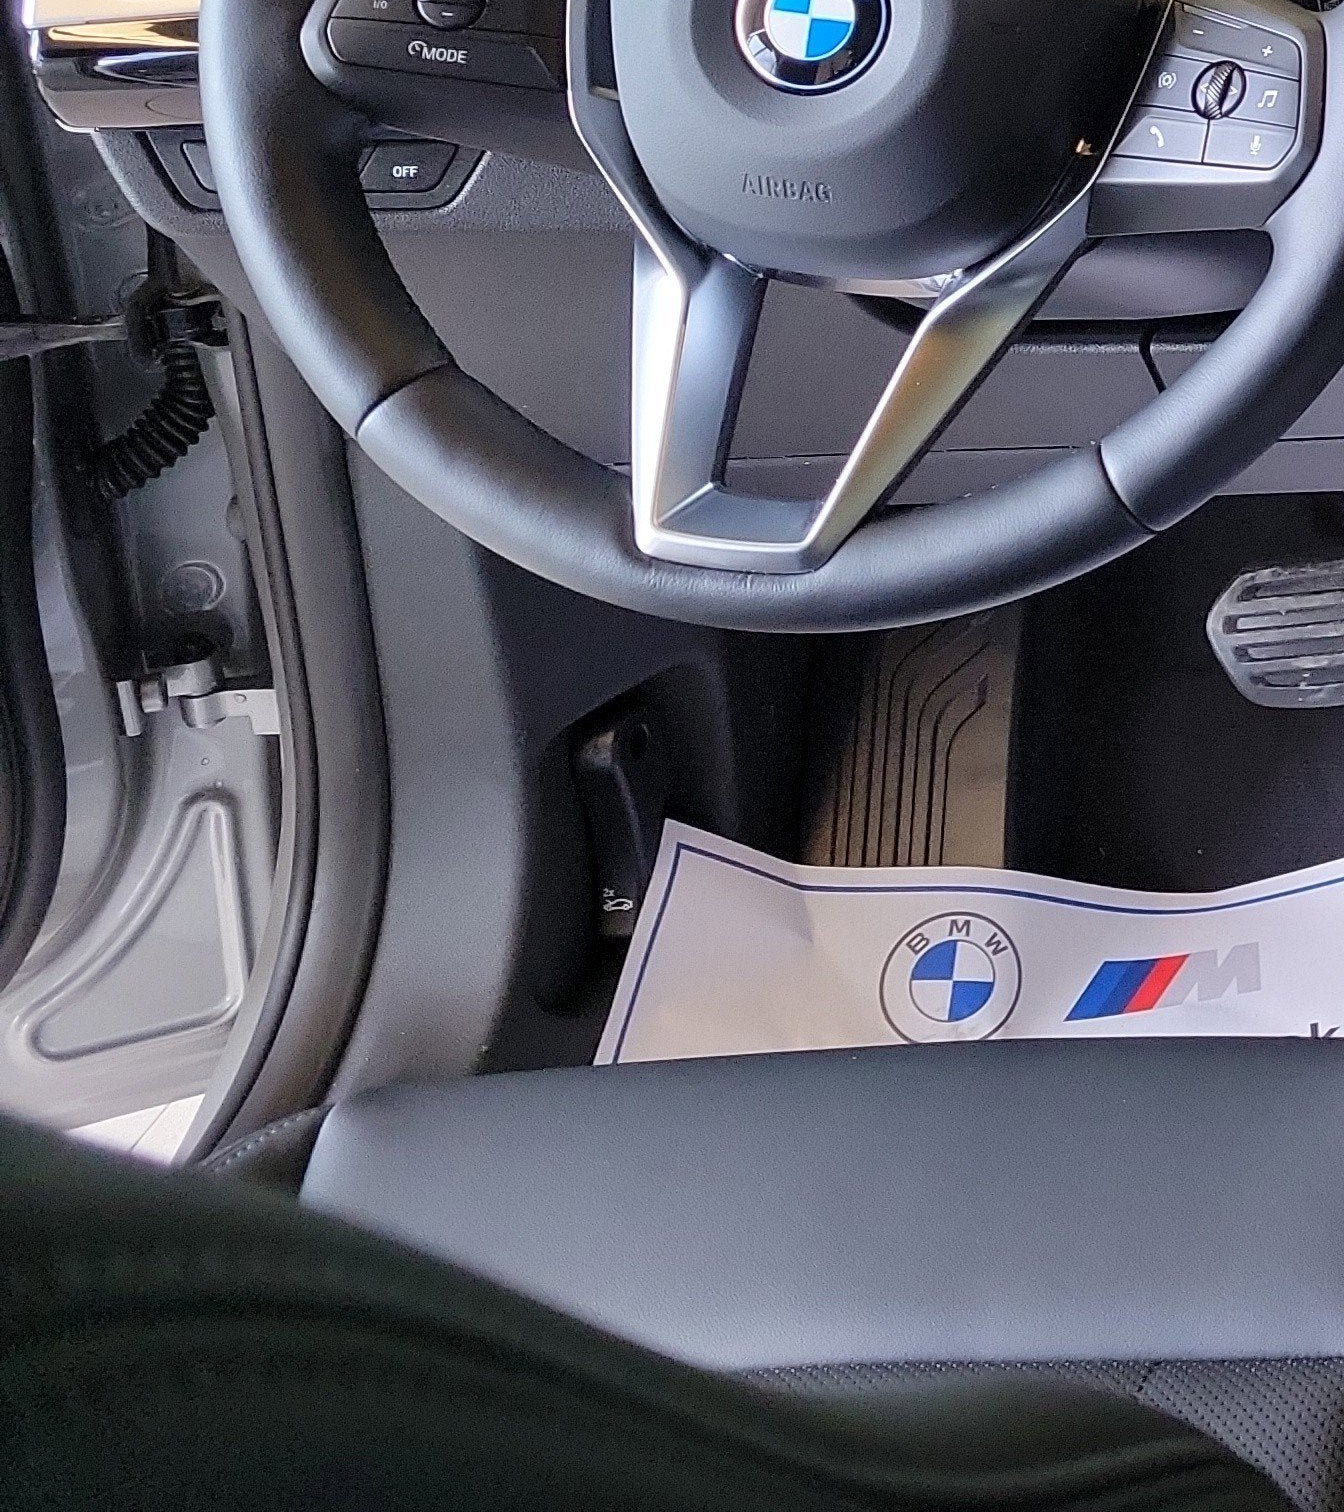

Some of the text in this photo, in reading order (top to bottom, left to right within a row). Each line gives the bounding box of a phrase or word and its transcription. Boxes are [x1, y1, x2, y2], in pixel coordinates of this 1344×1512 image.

[422, 46, 468, 65] MODE
[392, 165, 419, 178] OFF
[742, 173, 834, 204] AIRBAG
[905, 919, 1008, 956] BMW
